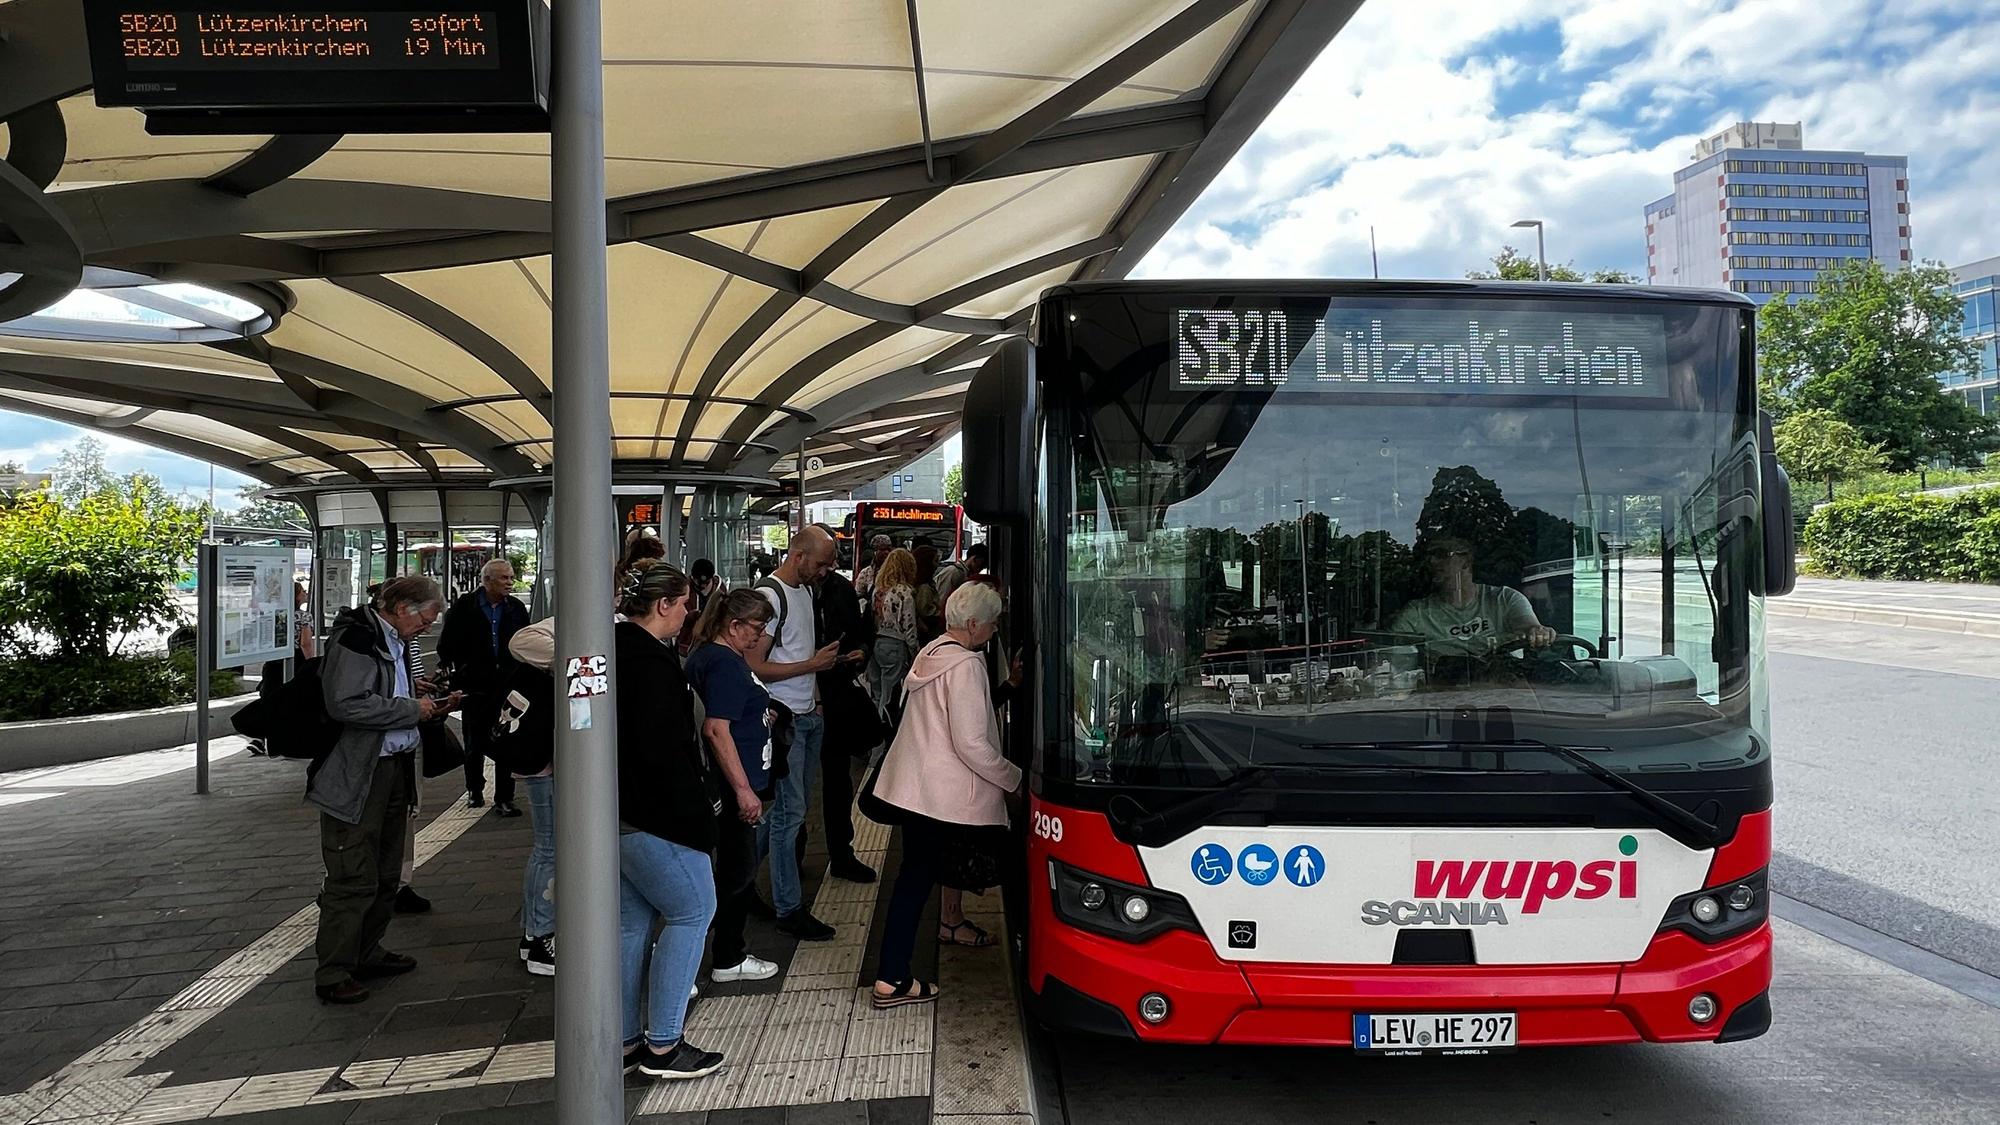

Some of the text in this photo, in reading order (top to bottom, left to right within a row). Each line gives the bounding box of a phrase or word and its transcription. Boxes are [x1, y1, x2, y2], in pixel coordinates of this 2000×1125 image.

[119, 14, 484, 36] SB20 Lützenkirchen sofort
[123, 38, 486, 57] SB20 Lützenkirchen 19 Min
[1178, 309, 1643, 386] SB20 Lützenkirchen
[811, 459, 819, 471] 8
[1034, 811, 1064, 842] 299
[1413, 835, 1639, 914] wupsi
[1361, 900, 1509, 926] SCANIA
[1360, 1035, 1367, 1043] D
[1371, 1017, 1513, 1044] LEV HE 297
